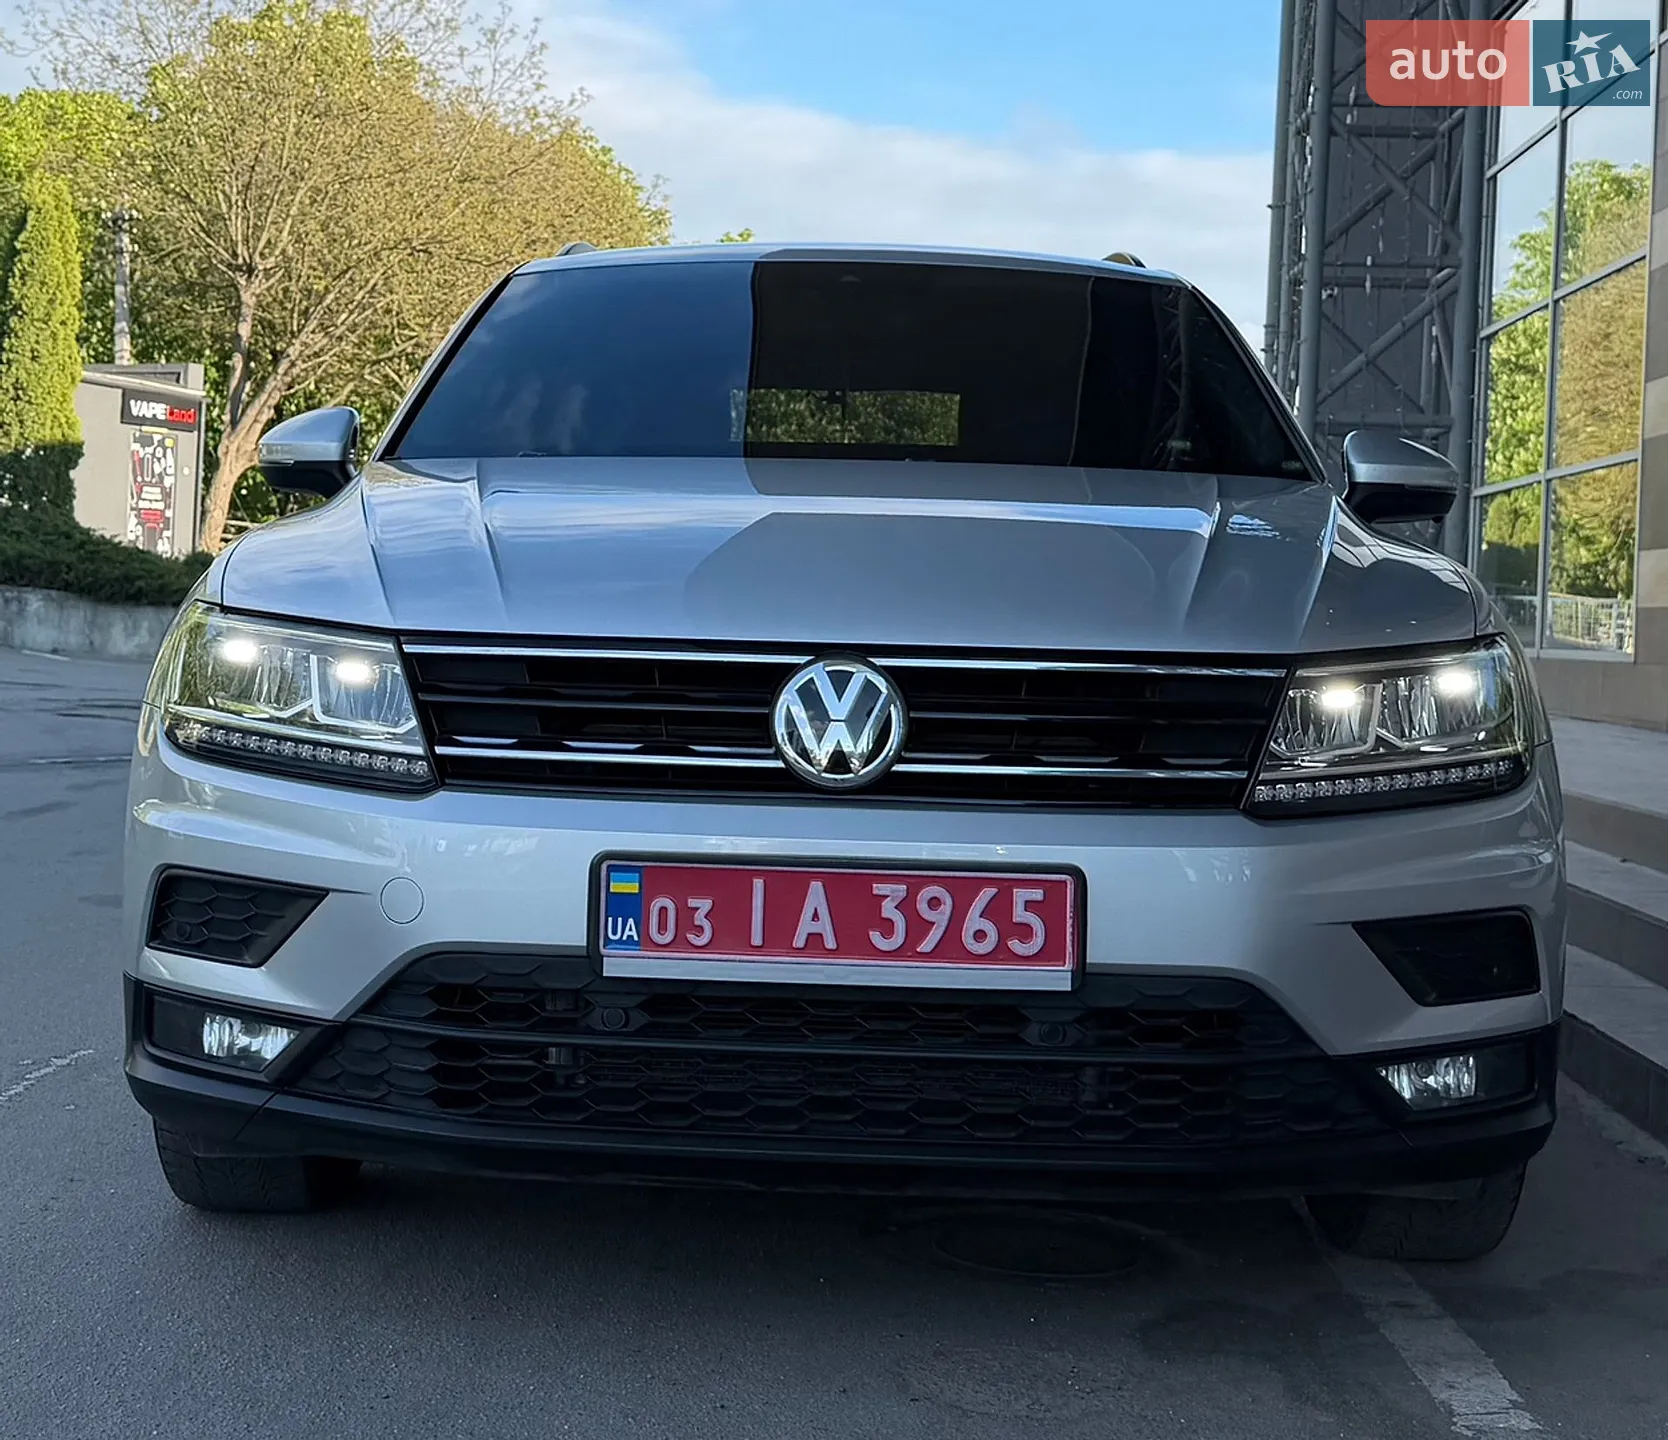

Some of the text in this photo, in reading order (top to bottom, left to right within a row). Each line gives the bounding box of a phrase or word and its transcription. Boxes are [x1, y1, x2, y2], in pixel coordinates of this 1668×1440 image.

[607, 917, 639, 941] UA
[649, 896, 714, 947] 03
[868, 882, 1046, 957] 3965
